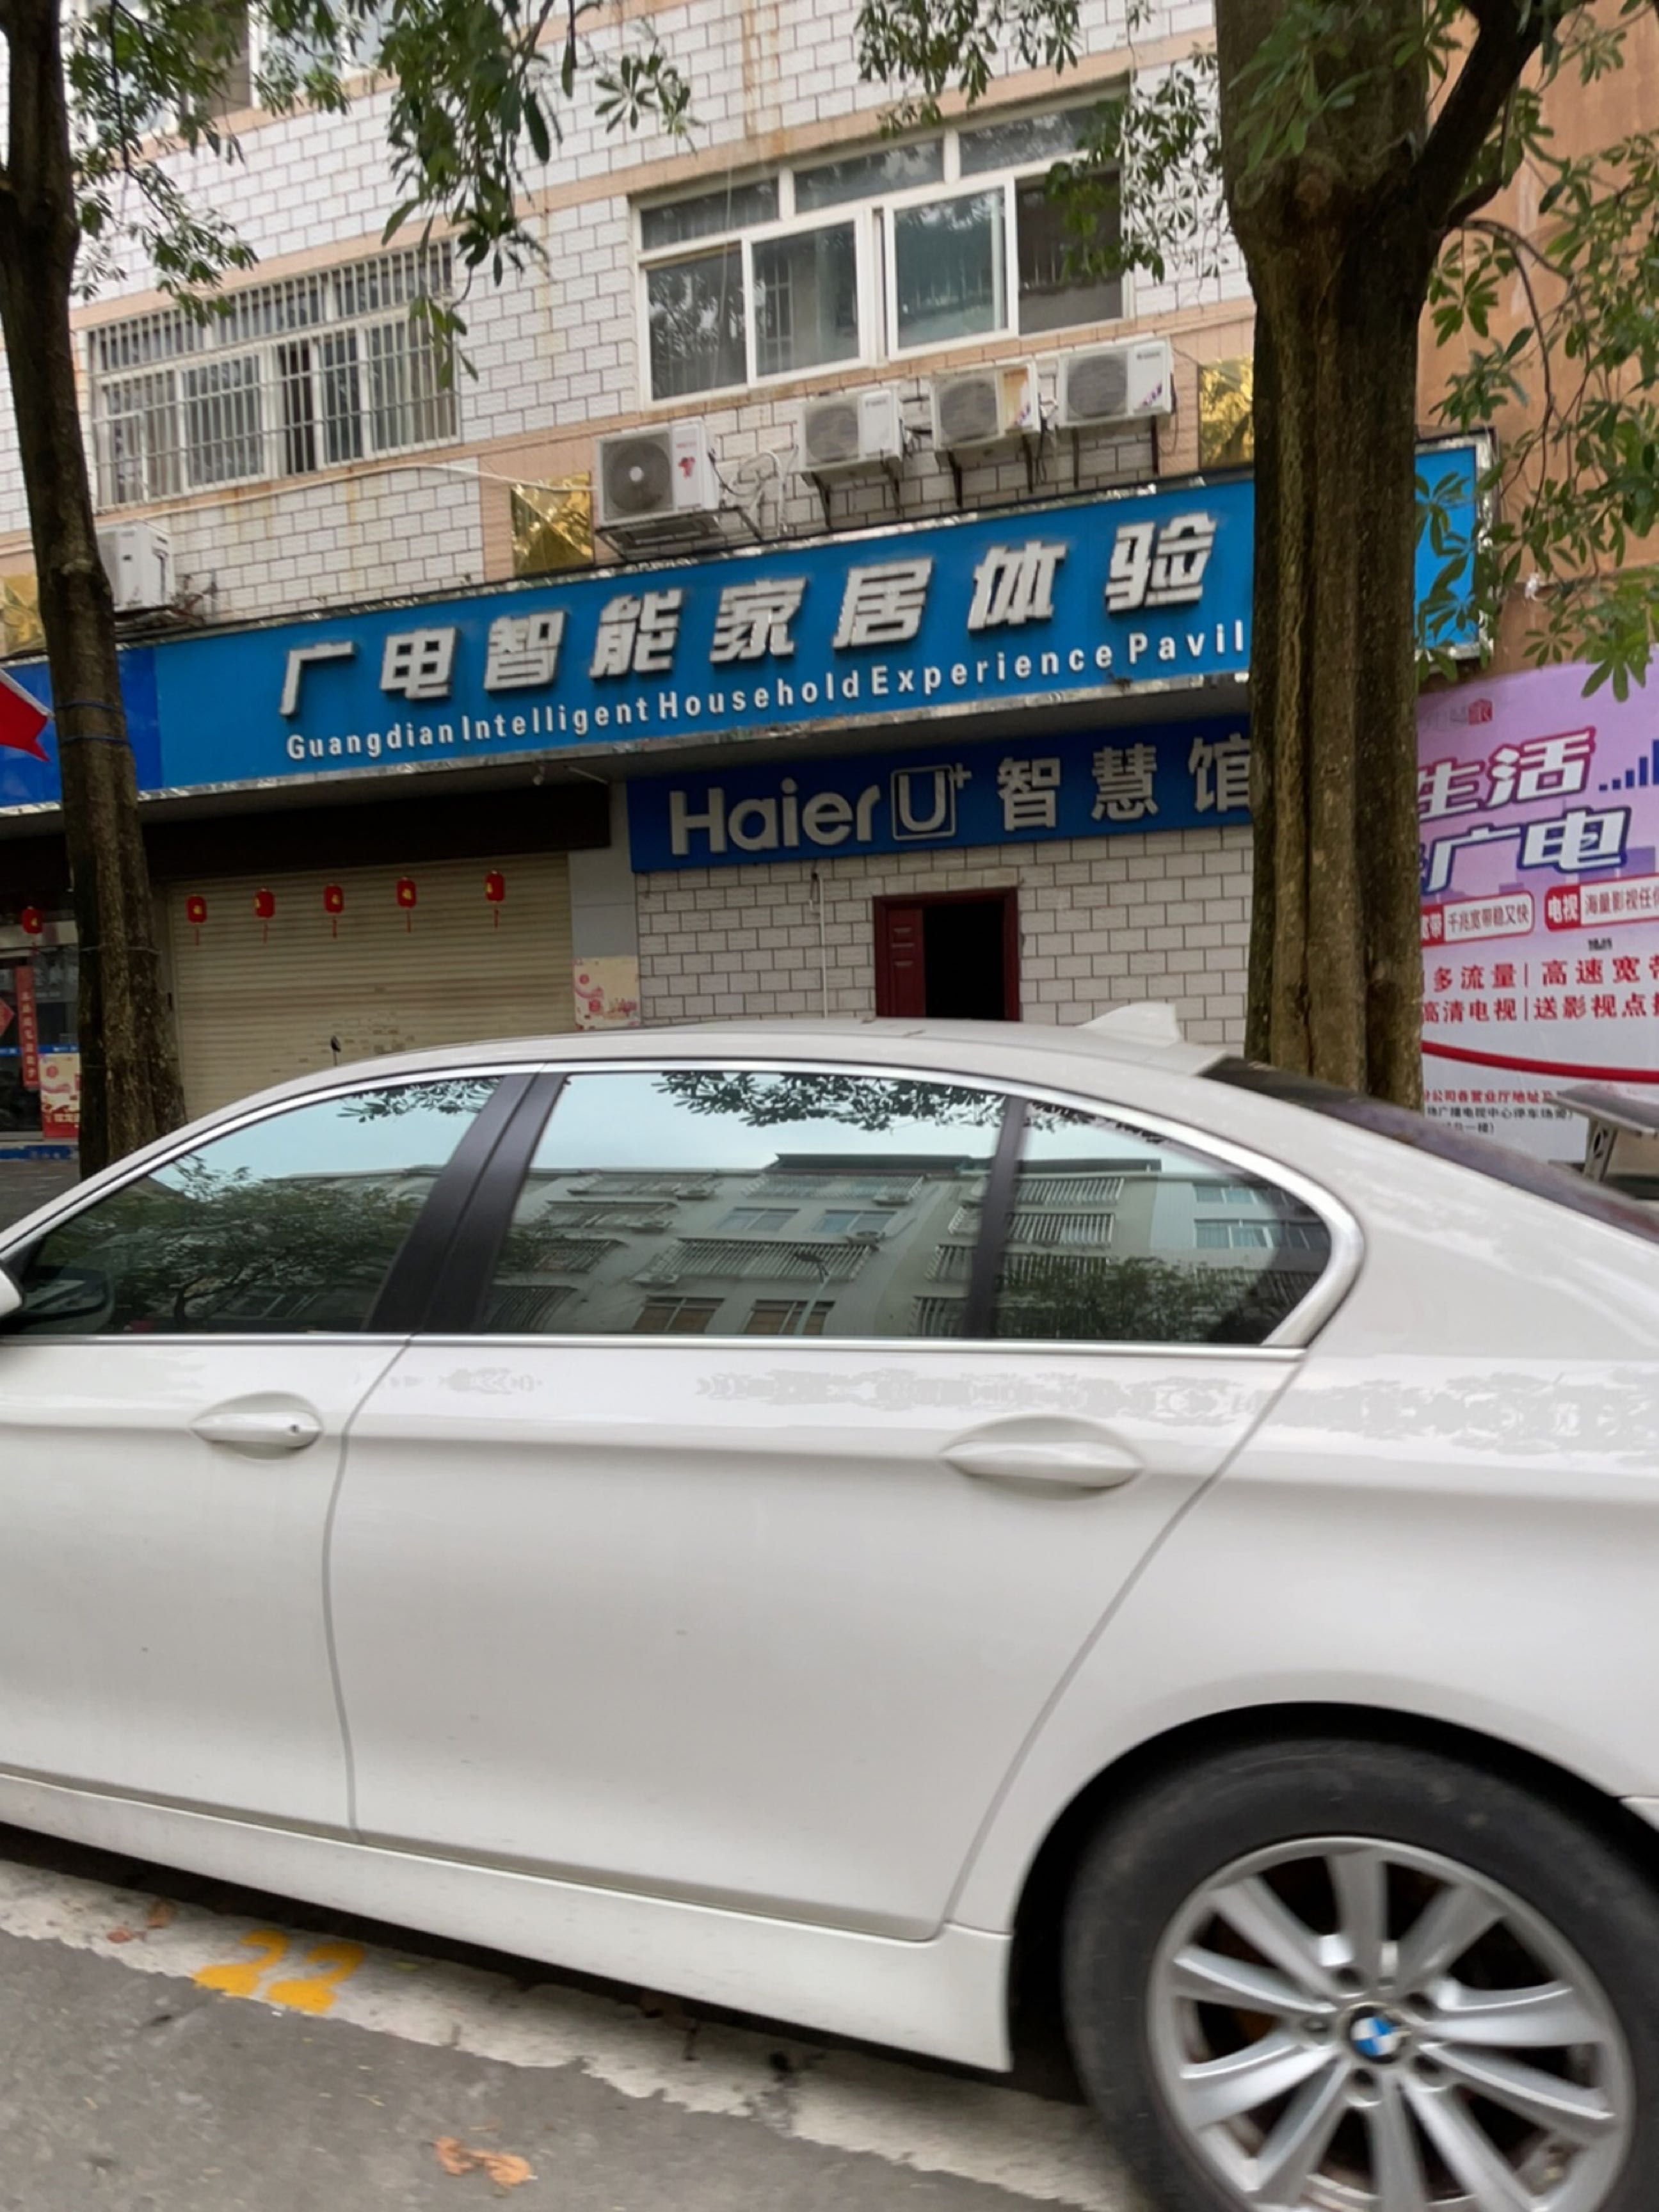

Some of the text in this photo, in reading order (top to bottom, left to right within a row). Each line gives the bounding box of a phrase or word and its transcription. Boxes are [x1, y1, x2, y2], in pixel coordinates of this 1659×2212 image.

[280, 513, 1216, 716] 广电智能家居体验
[286, 620, 1244, 760] Guangdian Intelligent Household Experience Pavil
[668, 777, 881, 857] Haier
[998, 733, 1249, 831] 智慧馆
[1418, 726, 1596, 822] 生活
[193, 1929, 364, 2014] 22
